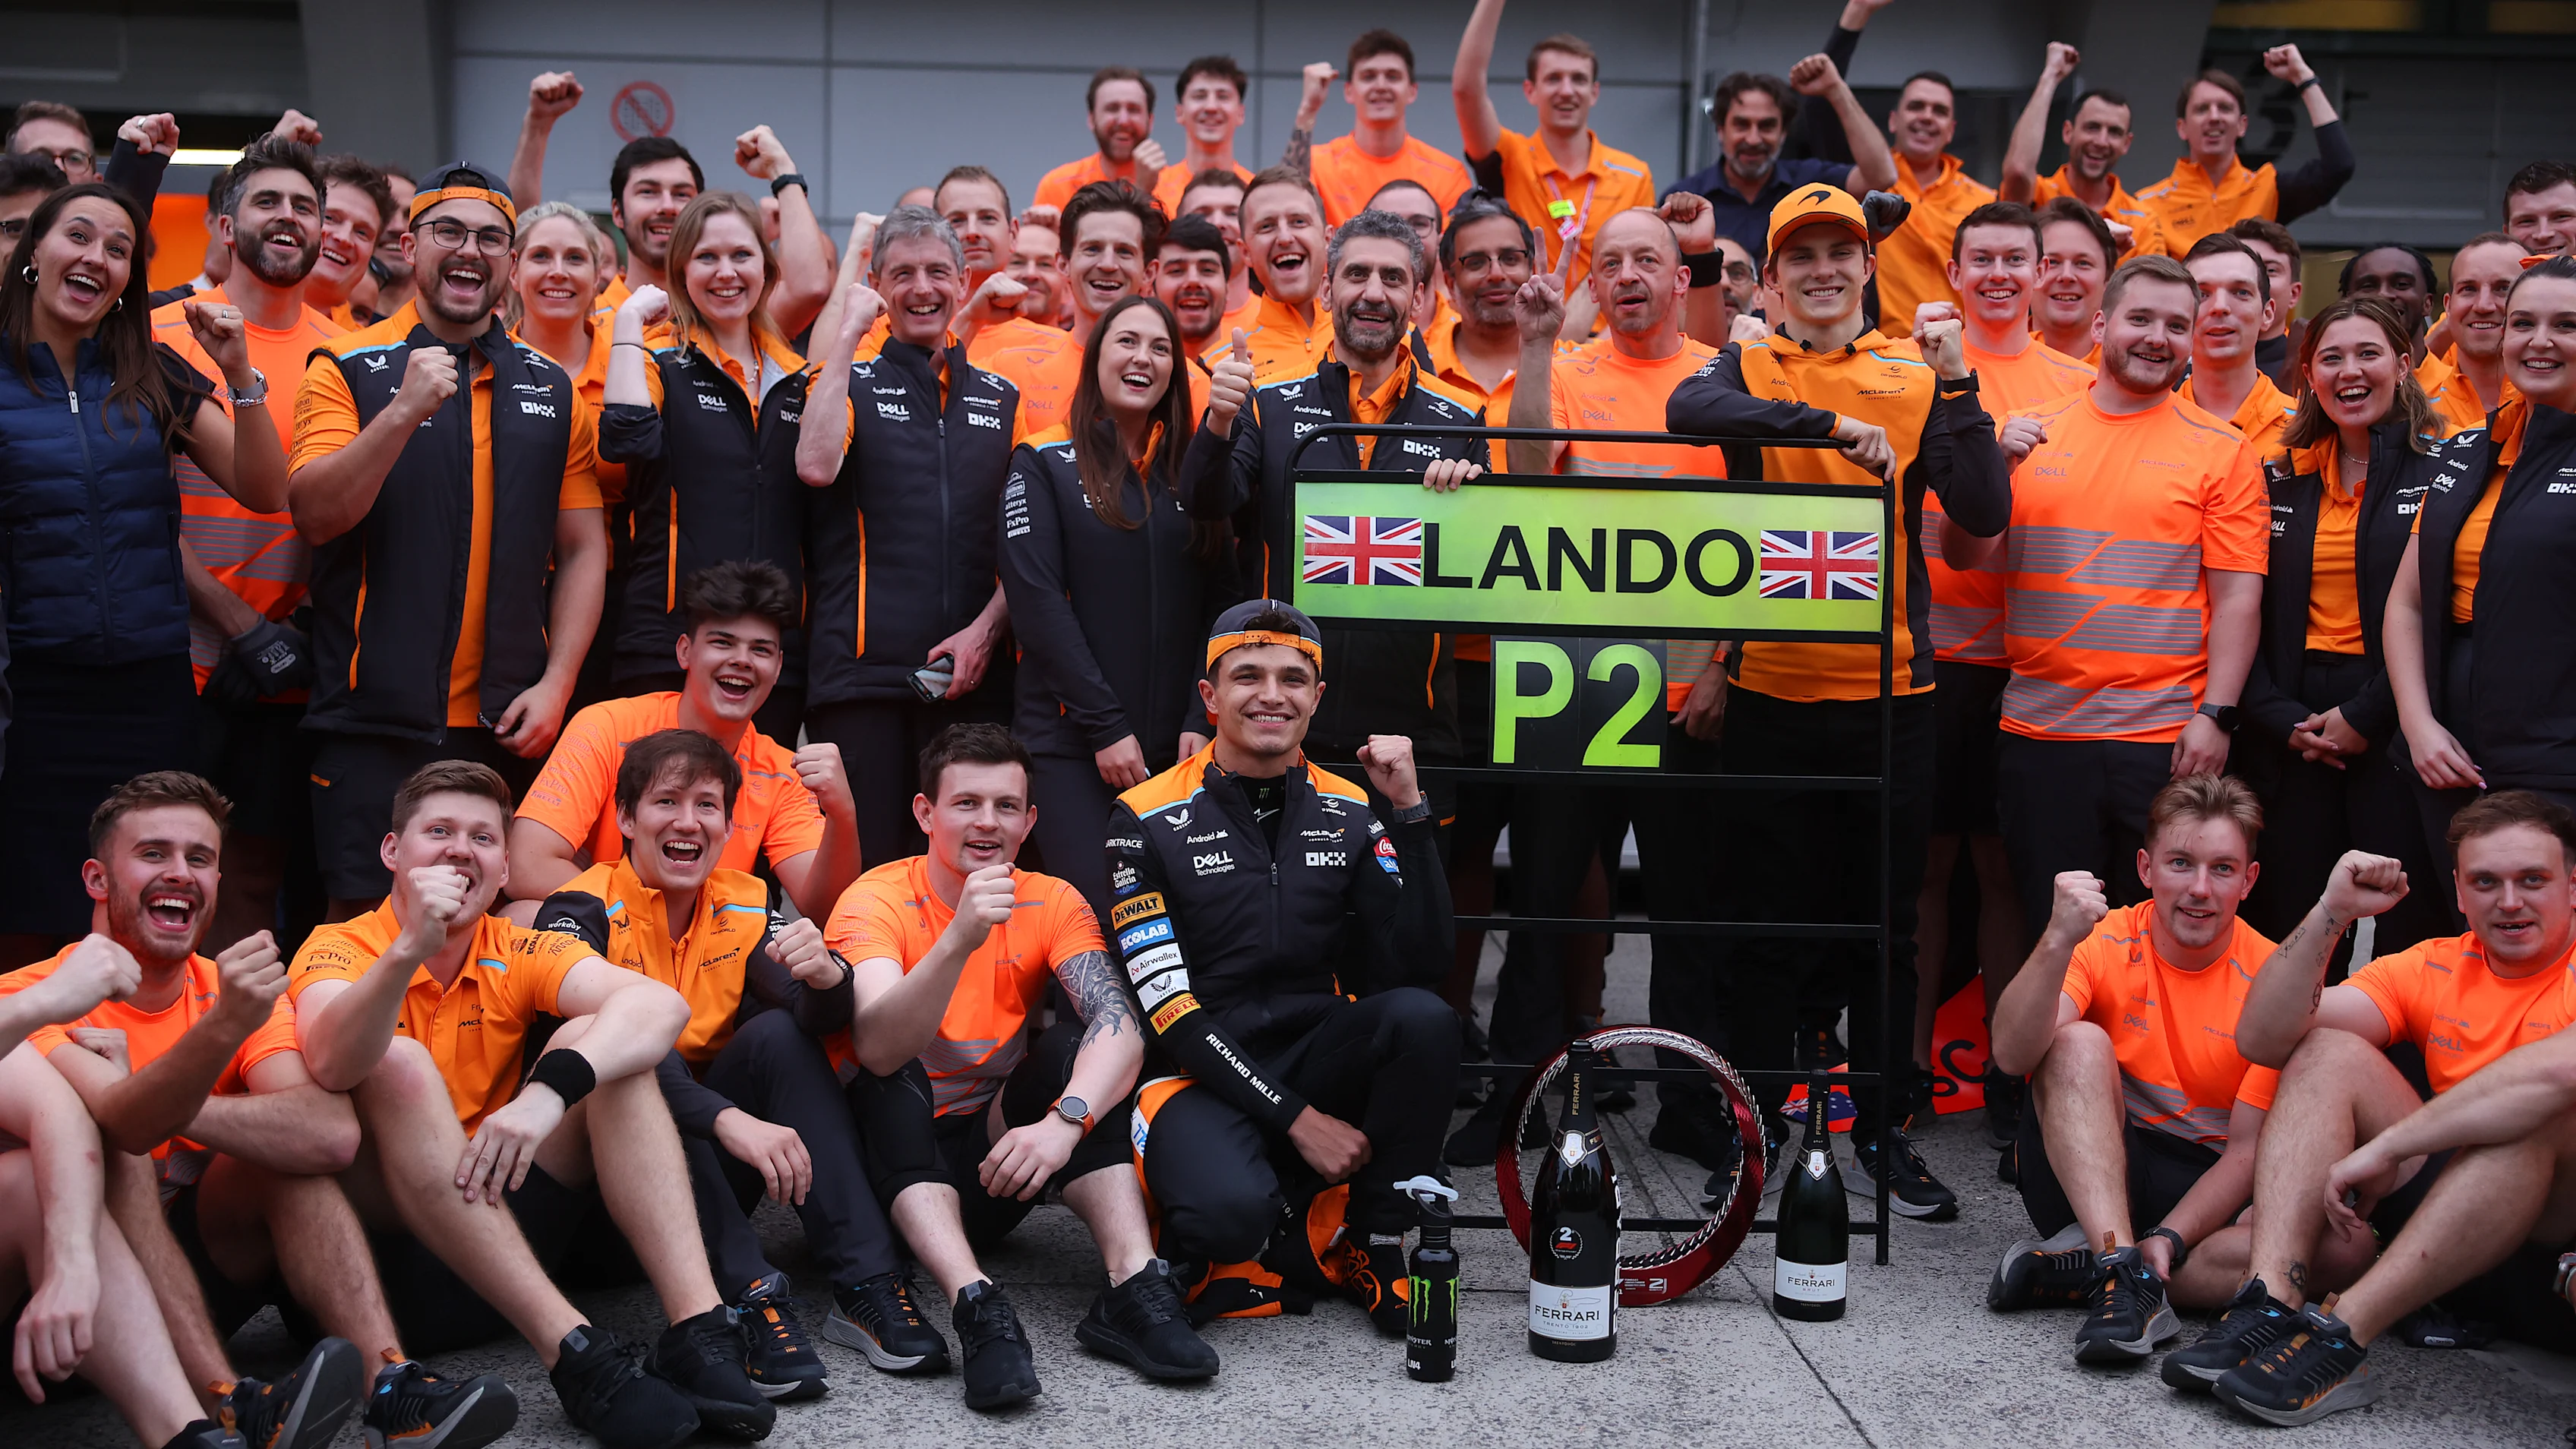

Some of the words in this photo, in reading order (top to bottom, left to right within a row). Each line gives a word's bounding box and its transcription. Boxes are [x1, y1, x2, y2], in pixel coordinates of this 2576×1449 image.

[1771, 378, 1792, 387] Andro
[873, 387, 896, 395] Android
[1857, 387, 1905, 396] McLaren
[697, 394, 727, 406] DELL
[963, 396, 1002, 406] McLaren
[1027, 399, 1053, 409] DELL
[520, 401, 556, 418] OKX
[876, 402, 910, 415] DELL
[1293, 405, 1321, 415] Android
[968, 412, 1002, 430] OKX
[1583, 410, 1615, 421] DELL
[1403, 439, 1441, 459] OKX
[2138, 459, 2186, 469] McLaren
[2447, 459, 2469, 471] Android
[2035, 467, 2067, 476] DELL
[2396, 485, 2429, 495] McLare
[1005, 498, 1027, 510] alteryx
[2398, 503, 2421, 514] OK
[1006, 516, 1029, 529] FxPro
[2271, 520, 2285, 532] ELL
[1423, 522, 1754, 597] LANDO
[1493, 640, 1662, 768] P2
[567, 735, 591, 753] Hilton
[553, 755, 582, 772] alteryx
[548, 766, 575, 781] vmware
[538, 776, 568, 794] FxPro
[531, 791, 561, 807] PIRELLI
[1326, 808, 1347, 816] WORLD
[1186, 832, 1215, 844] Android
[1300, 829, 1345, 838] McLaren
[1105, 838, 1143, 848] ARKTRACE
[1193, 851, 1233, 869] DELL
[1305, 852, 1346, 866] OKX
[1113, 867, 1135, 881] Estrella
[1195, 863, 1236, 876] Technologies
[1114, 876, 1136, 889] Galicia
[843, 904, 869, 912] Hilton
[548, 921, 582, 931] workday
[839, 935, 870, 951] FxPro
[1120, 923, 1169, 950] ECOLAB
[309, 952, 351, 964] FxPro
[1140, 952, 1178, 971] Airwallex
[2123, 1013, 2150, 1031] DELL
[2435, 1014, 2457, 1024] ndroid
[2428, 1032, 2464, 1052] DELL
[1206, 1033, 1251, 1078] RICHARD
[1249, 1075, 1283, 1105] MILLE
[1788, 1277, 1835, 1287] FERRARI
[1535, 1305, 1600, 1321] FERRARI
[1407, 1358, 1421, 1371] LN4
